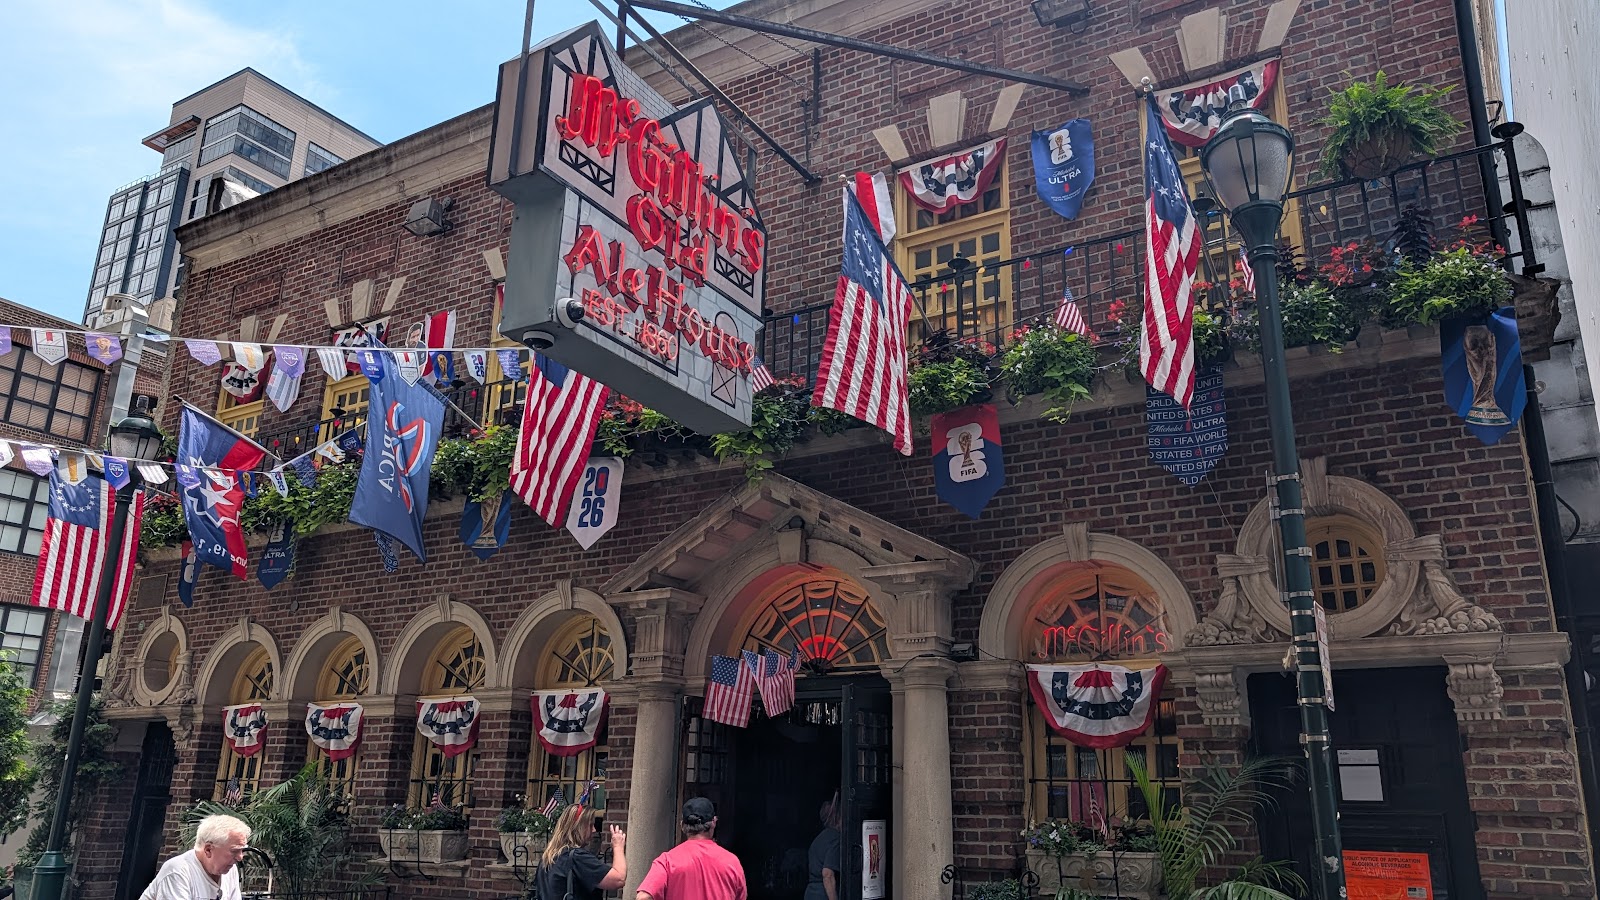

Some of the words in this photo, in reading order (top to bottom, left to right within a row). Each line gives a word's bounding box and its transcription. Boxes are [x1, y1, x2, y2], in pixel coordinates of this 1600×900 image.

[555, 72, 764, 275] McGillin's
[1049, 169, 1081, 184] ULTRA
[626, 193, 709, 287] Old
[634, 319, 679, 362] 1860
[471, 354, 484, 366] 20
[475, 365, 485, 377] 26
[1147, 411, 1176, 420] NITED
[1178, 405, 1213, 418] STATES
[1193, 417, 1225, 430] ULTRA
[1173, 436, 1196, 446] FIFA
[1195, 429, 1228, 443] WORLD
[1155, 450, 1193, 459] STATES
[1205, 444, 1224, 455] FIFA
[960, 467, 978, 477] FIFA
[583, 466, 610, 497] 20
[577, 497, 605, 528] 26
[1038, 623, 1167, 659] McGillin's
